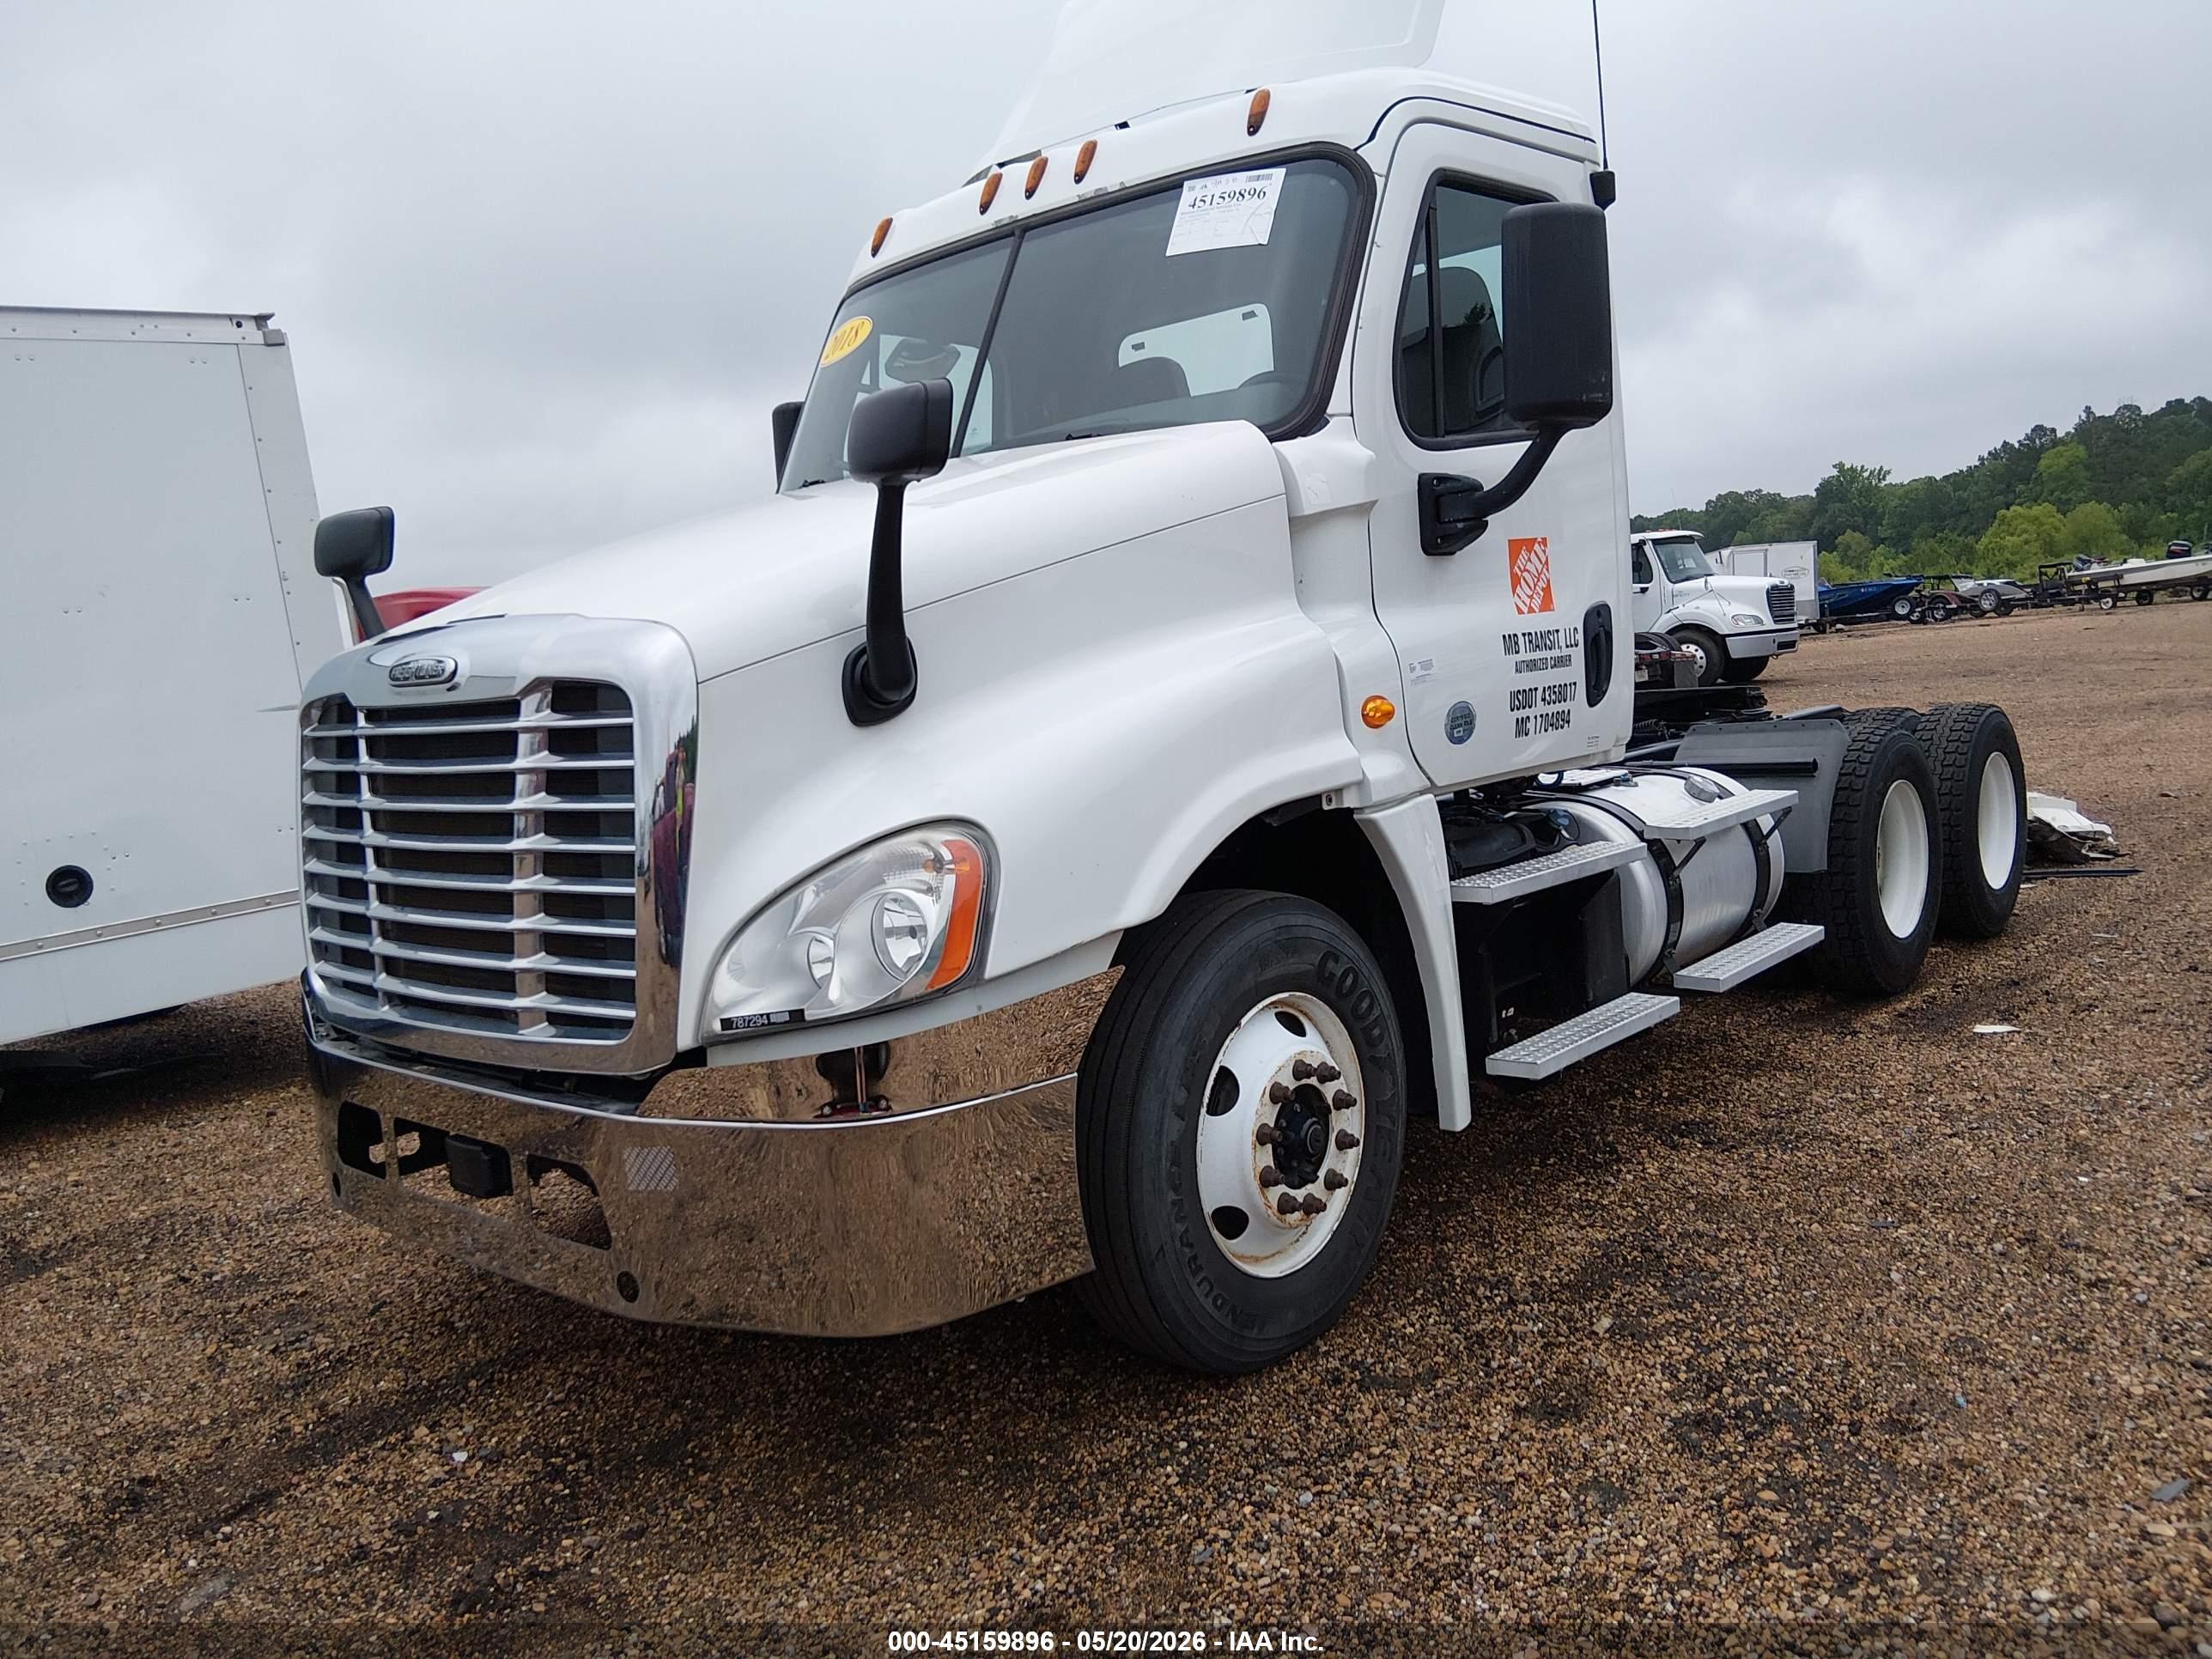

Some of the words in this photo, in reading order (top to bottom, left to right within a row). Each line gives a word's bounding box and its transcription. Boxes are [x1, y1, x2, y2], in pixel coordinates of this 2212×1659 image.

[1188, 185, 1267, 209] 45159896
[824, 321, 865, 360] 2018
[1512, 544, 1530, 577] THE
[1512, 537, 1549, 615] HOME
[1502, 633, 1520, 656] MB
[1521, 629, 1563, 653] TRANSIT,
[1564, 627, 1579, 648] LLC
[1515, 657, 1548, 674] AUTHORIZED
[1549, 653, 1572, 670] CARRIER
[1510, 687, 1539, 712] USDOT
[1540, 681, 1577, 707] 4358017
[1515, 715, 1530, 738] MC
[1534, 708, 1571, 735] 1704894
[731, 1014, 769, 1029] 787294
